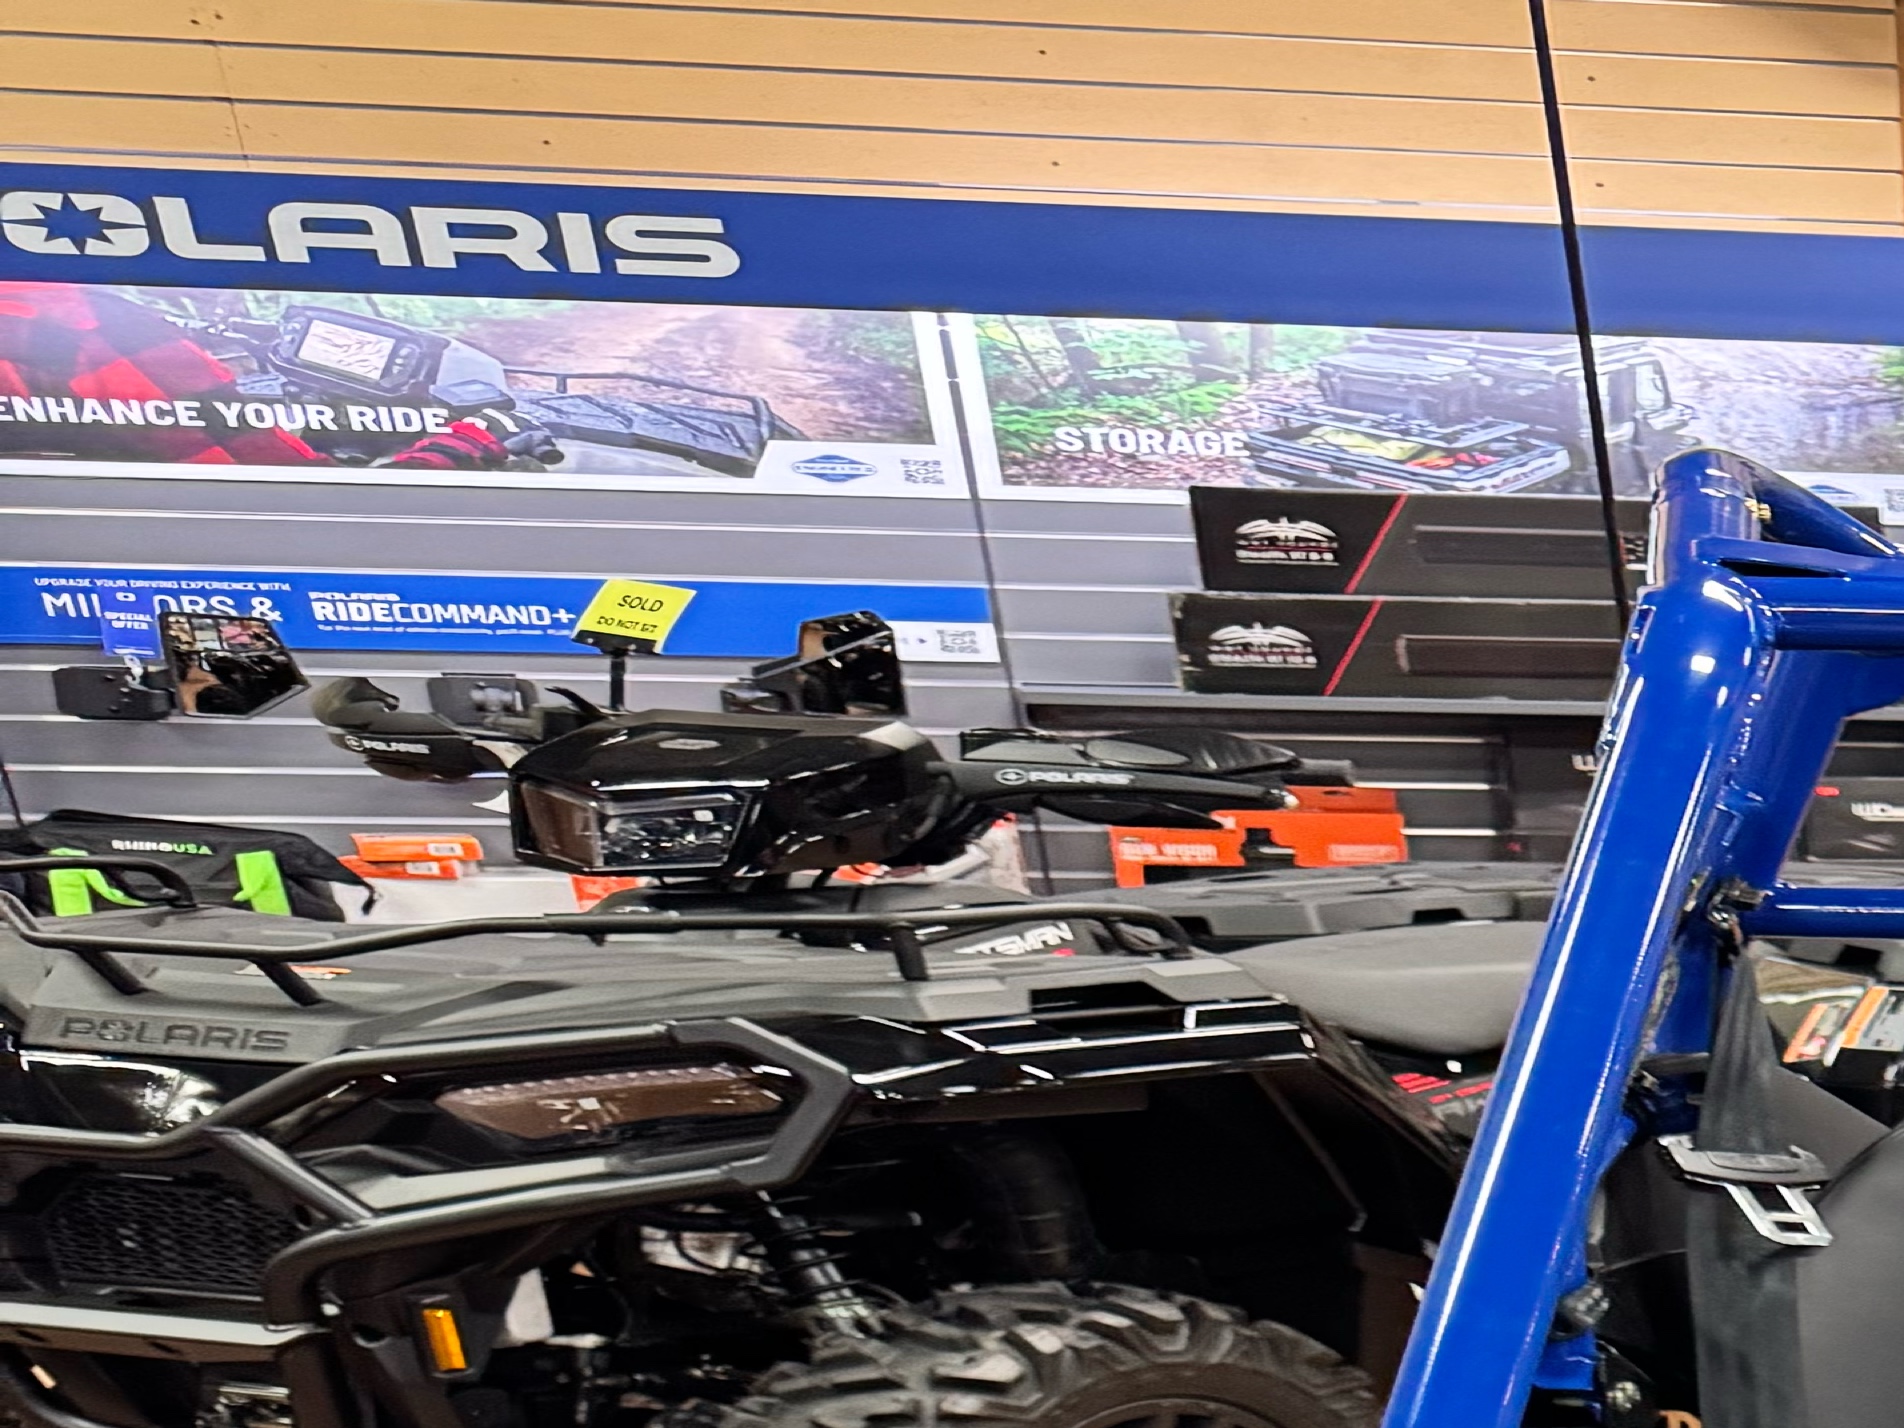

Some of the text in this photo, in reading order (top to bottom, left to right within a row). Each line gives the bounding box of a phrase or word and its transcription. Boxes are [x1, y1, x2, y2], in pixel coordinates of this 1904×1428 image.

[213, 401, 340, 433] YOUR
[346, 405, 453, 435] RIDE
[1053, 426, 1251, 458] STORAGE
[251, 597, 284, 622] &
[312, 601, 577, 625] RIDECOMMAND+
[617, 594, 664, 613] SOLD
[596, 616, 616, 626] DO
[111, 839, 215, 856] RHINOUSA
[60, 1016, 292, 1053] POLARIS
